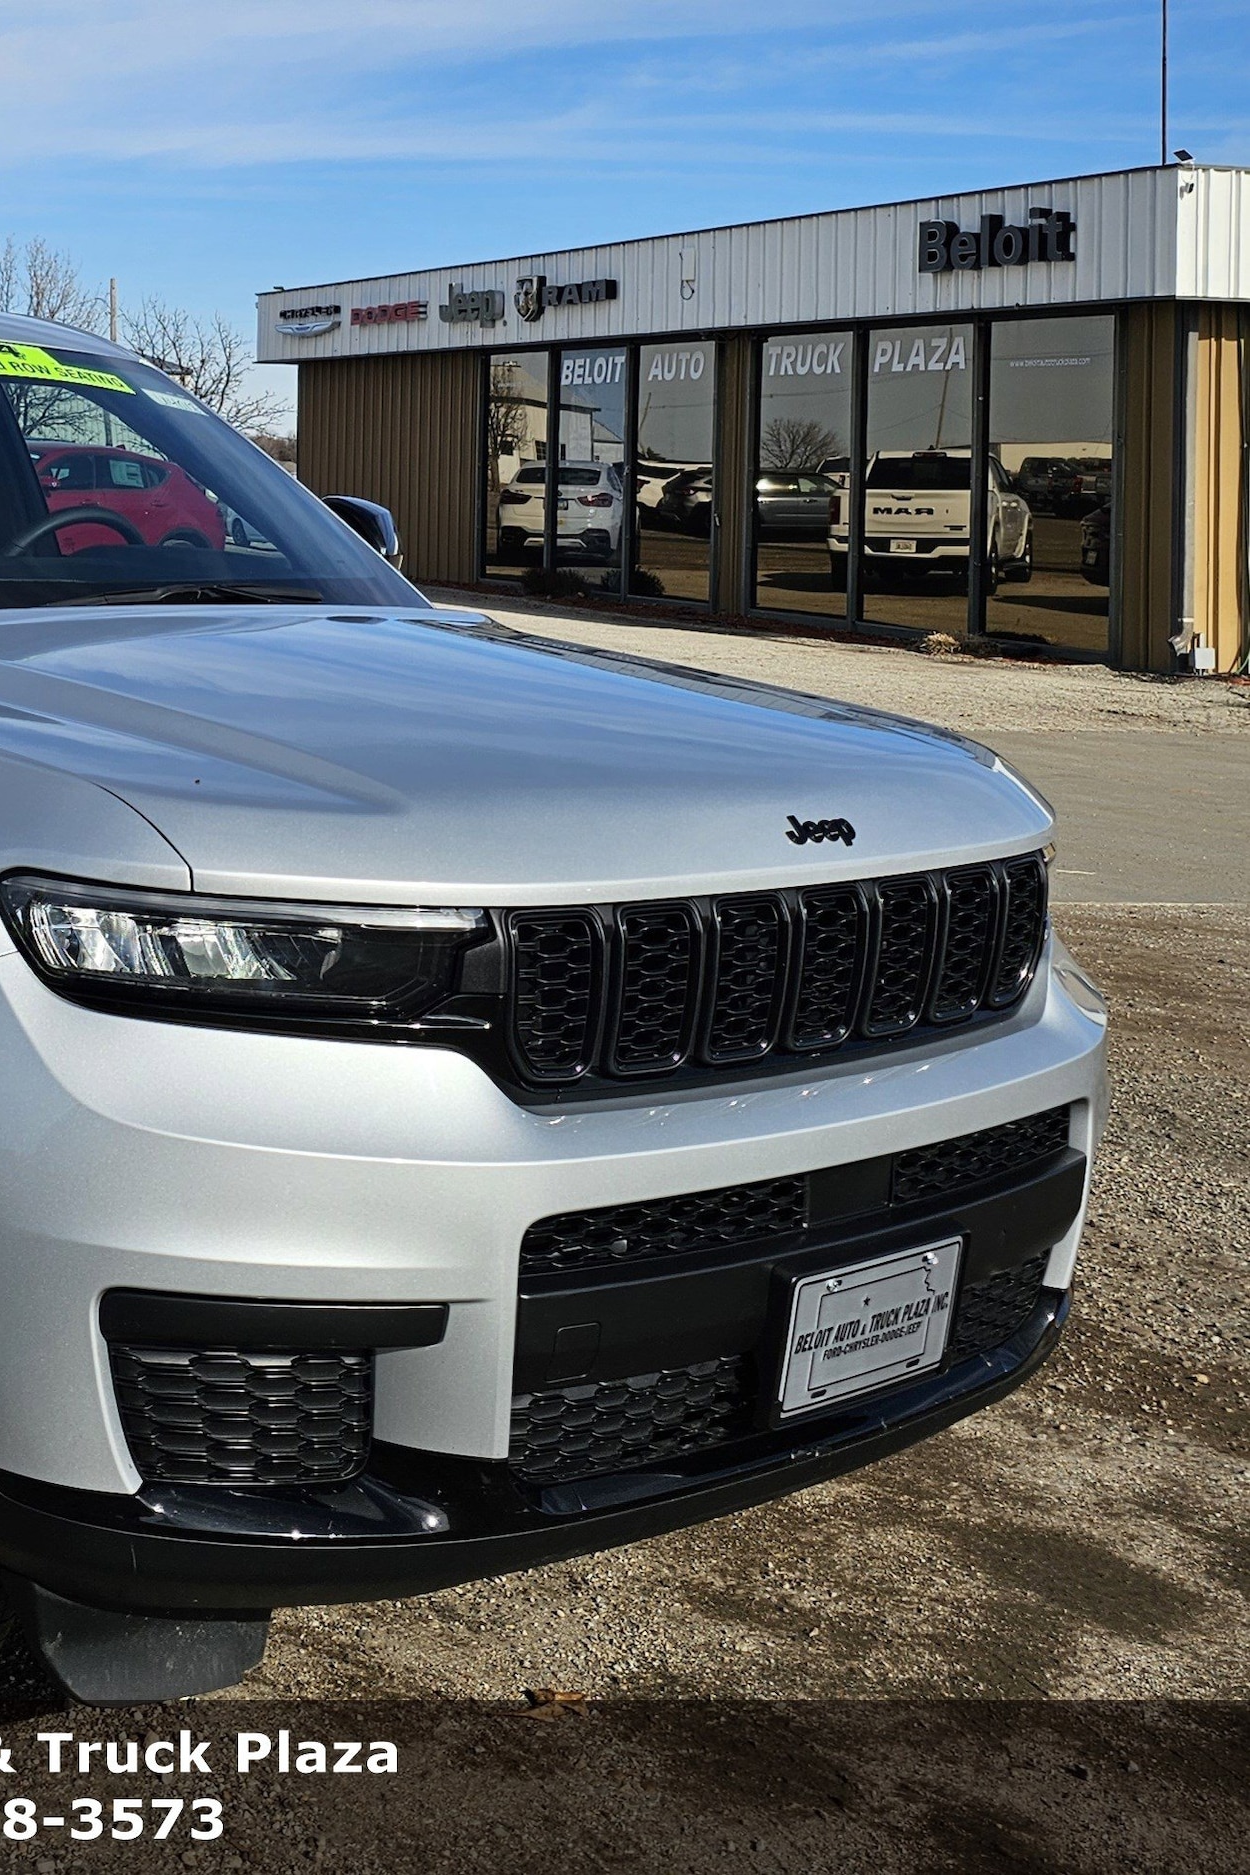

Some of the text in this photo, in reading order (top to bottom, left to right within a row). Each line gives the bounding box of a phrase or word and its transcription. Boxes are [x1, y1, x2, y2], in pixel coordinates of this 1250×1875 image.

[919, 207, 1076, 274] Beloit
[439, 282, 505, 329] Jeep
[541, 278, 617, 307] RAM
[279, 304, 341, 320] CHRYSLER
[350, 300, 427, 326] DODGE
[10, 361, 51, 376] ROW
[53, 366, 126, 389] SEATING
[561, 335, 967, 386] BELOIT AUTO TRUCK PLAZA
[785, 814, 856, 847] Jeep
[794, 1327, 834, 1355] BELOIT
[833, 1318, 860, 1344] AUTO
[869, 1306, 903, 1333] TRUCK
[901, 1297, 932, 1323] PLAZA
